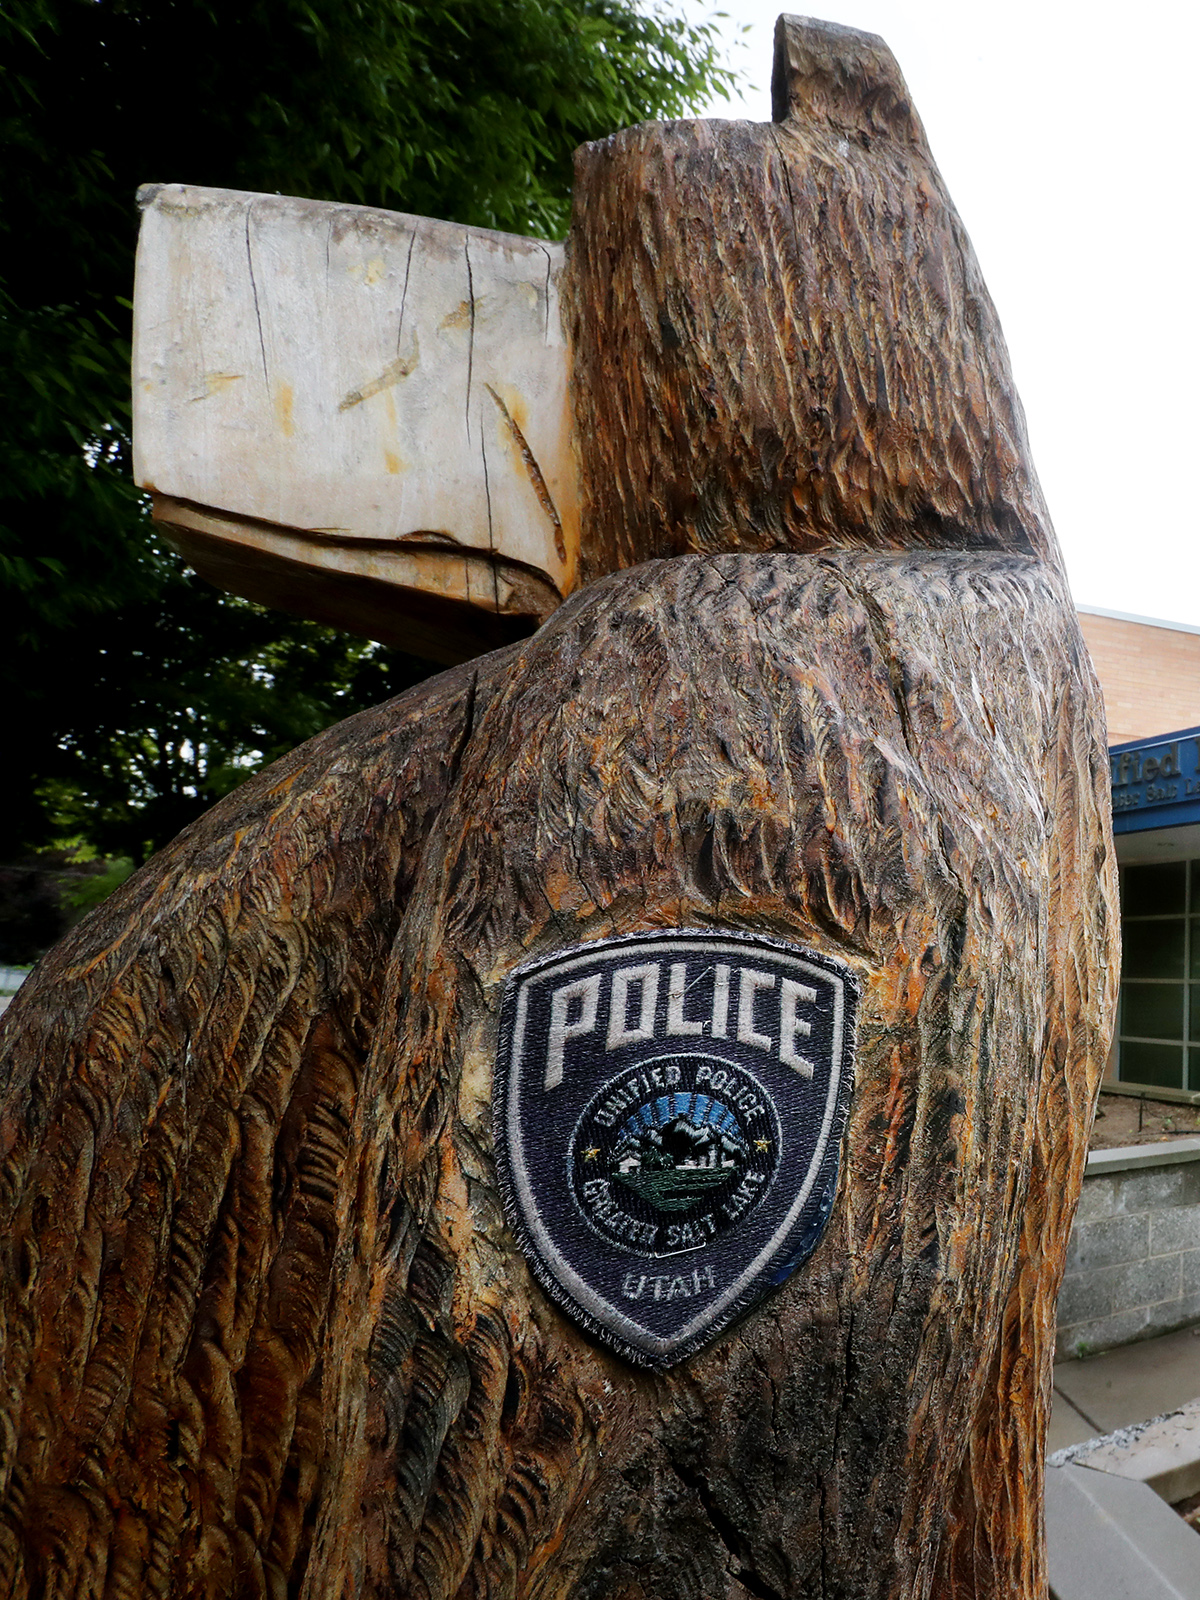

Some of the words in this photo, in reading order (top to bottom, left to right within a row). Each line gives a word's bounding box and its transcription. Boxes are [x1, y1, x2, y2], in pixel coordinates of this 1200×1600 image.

[1111, 741, 1181, 787] ified
[1146, 782, 1177, 802] Salt
[544, 962, 818, 1091] POLICE
[594, 1066, 682, 1127] UNIFIED
[696, 1065, 765, 1125] POLICE
[583, 1178, 659, 1244] GREATER
[667, 1213, 716, 1246] SALT
[722, 1169, 765, 1220] LAKE
[622, 1265, 715, 1300] UTAH
